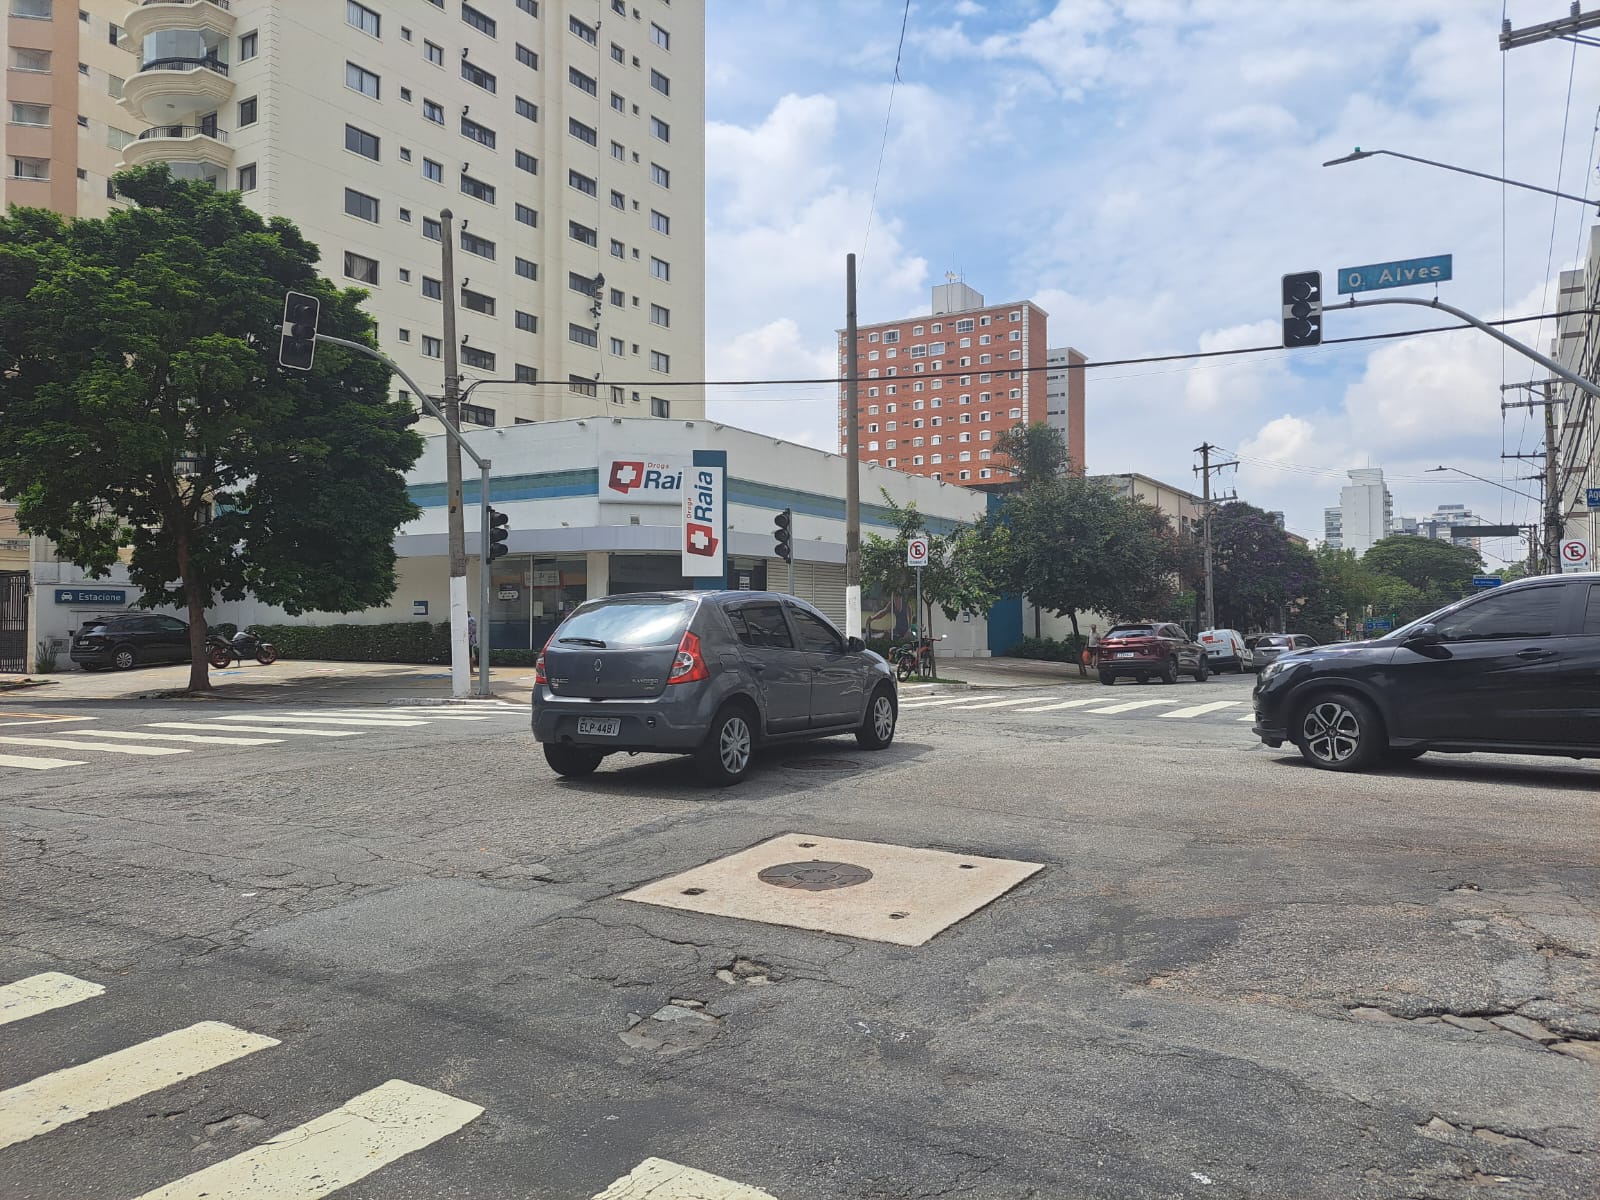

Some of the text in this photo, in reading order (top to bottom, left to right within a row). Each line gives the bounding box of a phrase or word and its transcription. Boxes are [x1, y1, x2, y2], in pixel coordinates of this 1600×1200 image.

[1348, 265, 1441, 288] O. Alves
[647, 462, 670, 470] Droga
[643, 470, 682, 490] Rai
[694, 471, 713, 523] Raia
[79, 592, 121, 601] Estacione
